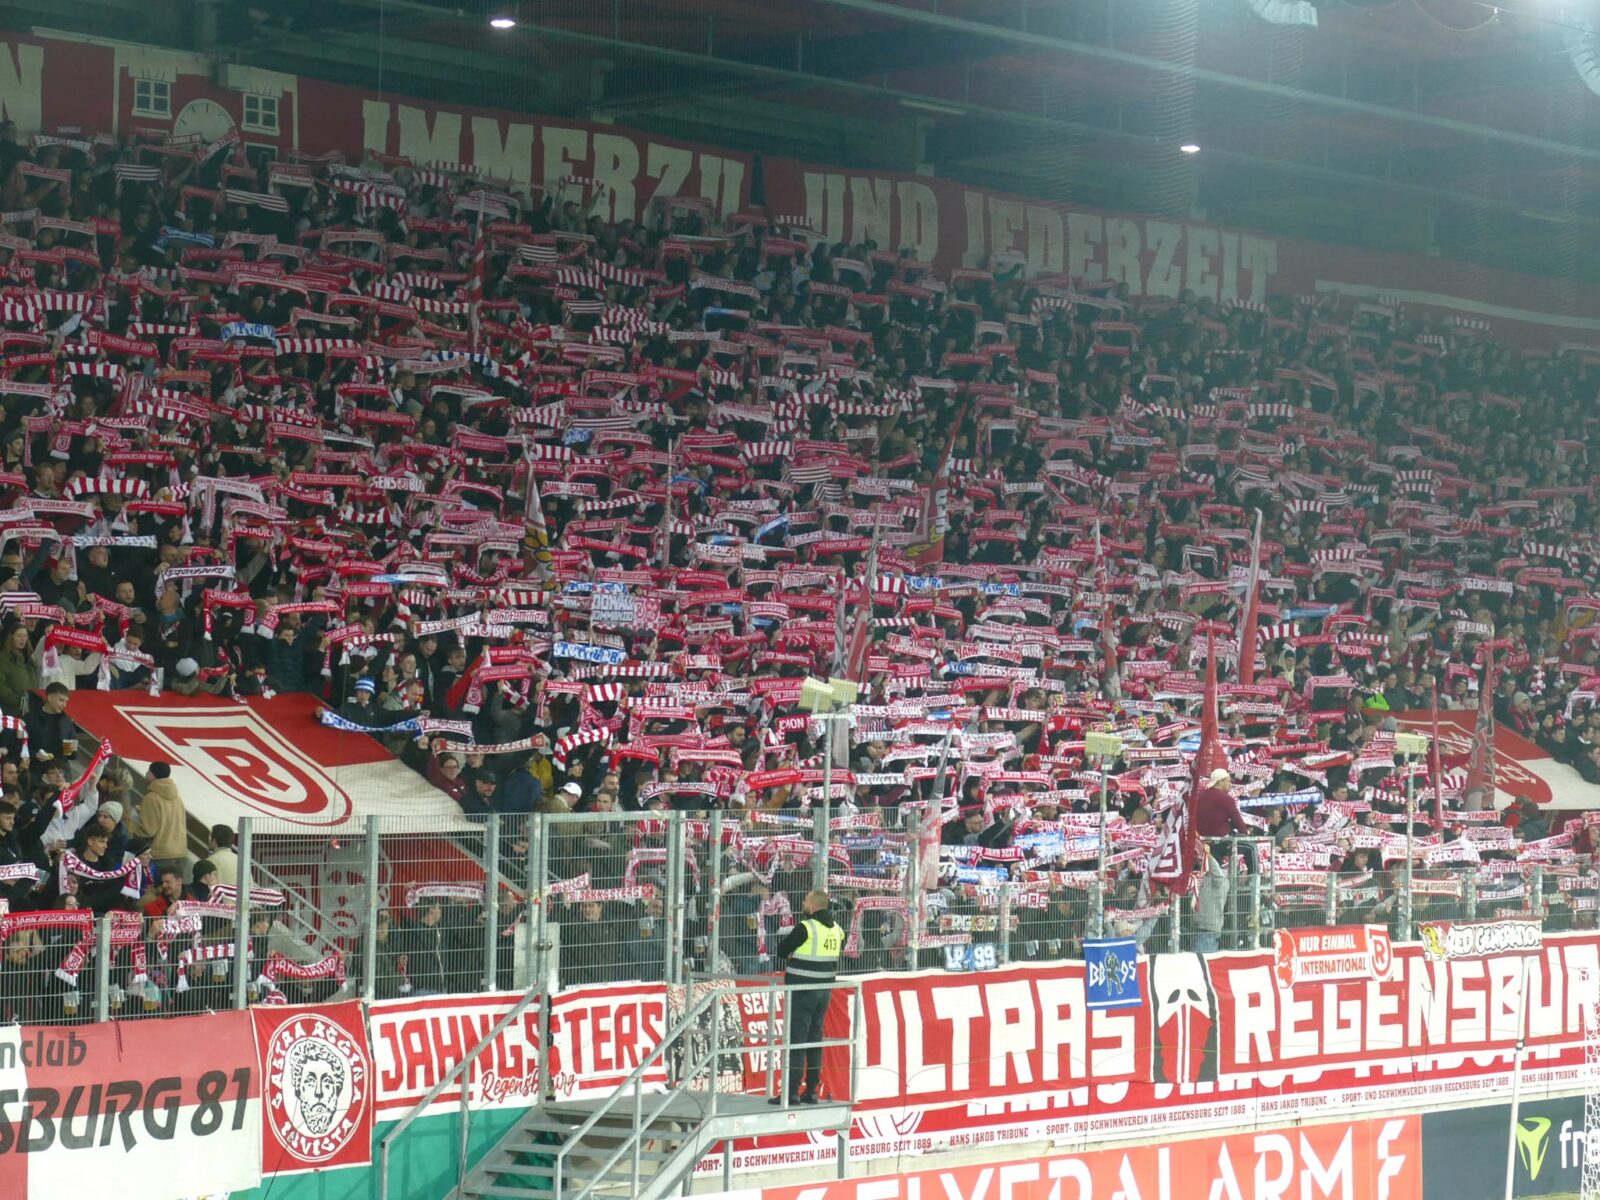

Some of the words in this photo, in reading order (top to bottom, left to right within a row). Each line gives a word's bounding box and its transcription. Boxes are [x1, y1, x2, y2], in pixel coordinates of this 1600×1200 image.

[804, 173, 938, 262] UND
[852, 514, 904, 526] REGENBURG
[1040, 755, 1073, 764] JAHNELF
[1071, 772, 1101, 782] JAHNEL
[15, 915, 37, 926] JAHN
[824, 939, 837, 950] 413
[1300, 936, 1320, 952] NUR
[1321, 933, 1356, 950] EINMAL
[1300, 957, 1366, 976] INTERNATIONAL
[380, 1002, 664, 1092] JAHNGSTERS
[847, 976, 1136, 1103] ULTRAS
[190, 1067, 250, 1136] 81
[744, 1150, 815, 1168] SCHWIMMVEREIN
[816, 1147, 837, 1160] JAHN
[893, 1140, 911, 1153] SEIT
[913, 1138, 932, 1150] 1889
[949, 1131, 971, 1146] HANS
[972, 1129, 995, 1143] JAKOB
[997, 1126, 1029, 1140] TRIBÜNE
[1073, 1121, 1089, 1133] UND
[1090, 1113, 1149, 1131] SCHWIMMVEREIN
[1150, 1112, 1168, 1123] JAHN
[1168, 1108, 1212, 1122] REGENSBURG
[1213, 1106, 1228, 1116] SEIT
[1231, 1104, 1246, 1115] 1889
[1261, 1101, 1278, 1112] HANS
[1279, 1098, 1299, 1110] JAKOB
[1300, 1094, 1328, 1107] TRIBÜNE
[1364, 1090, 1377, 1101] UND
[1378, 1084, 1428, 1100] SCHWIMMVEREIN
[1428, 1082, 1443, 1093] JAHN
[1444, 1078, 1481, 1092] REGENSBURG
[1482, 1077, 1495, 1088] SEIT
[1521, 1072, 1536, 1084] HANS
